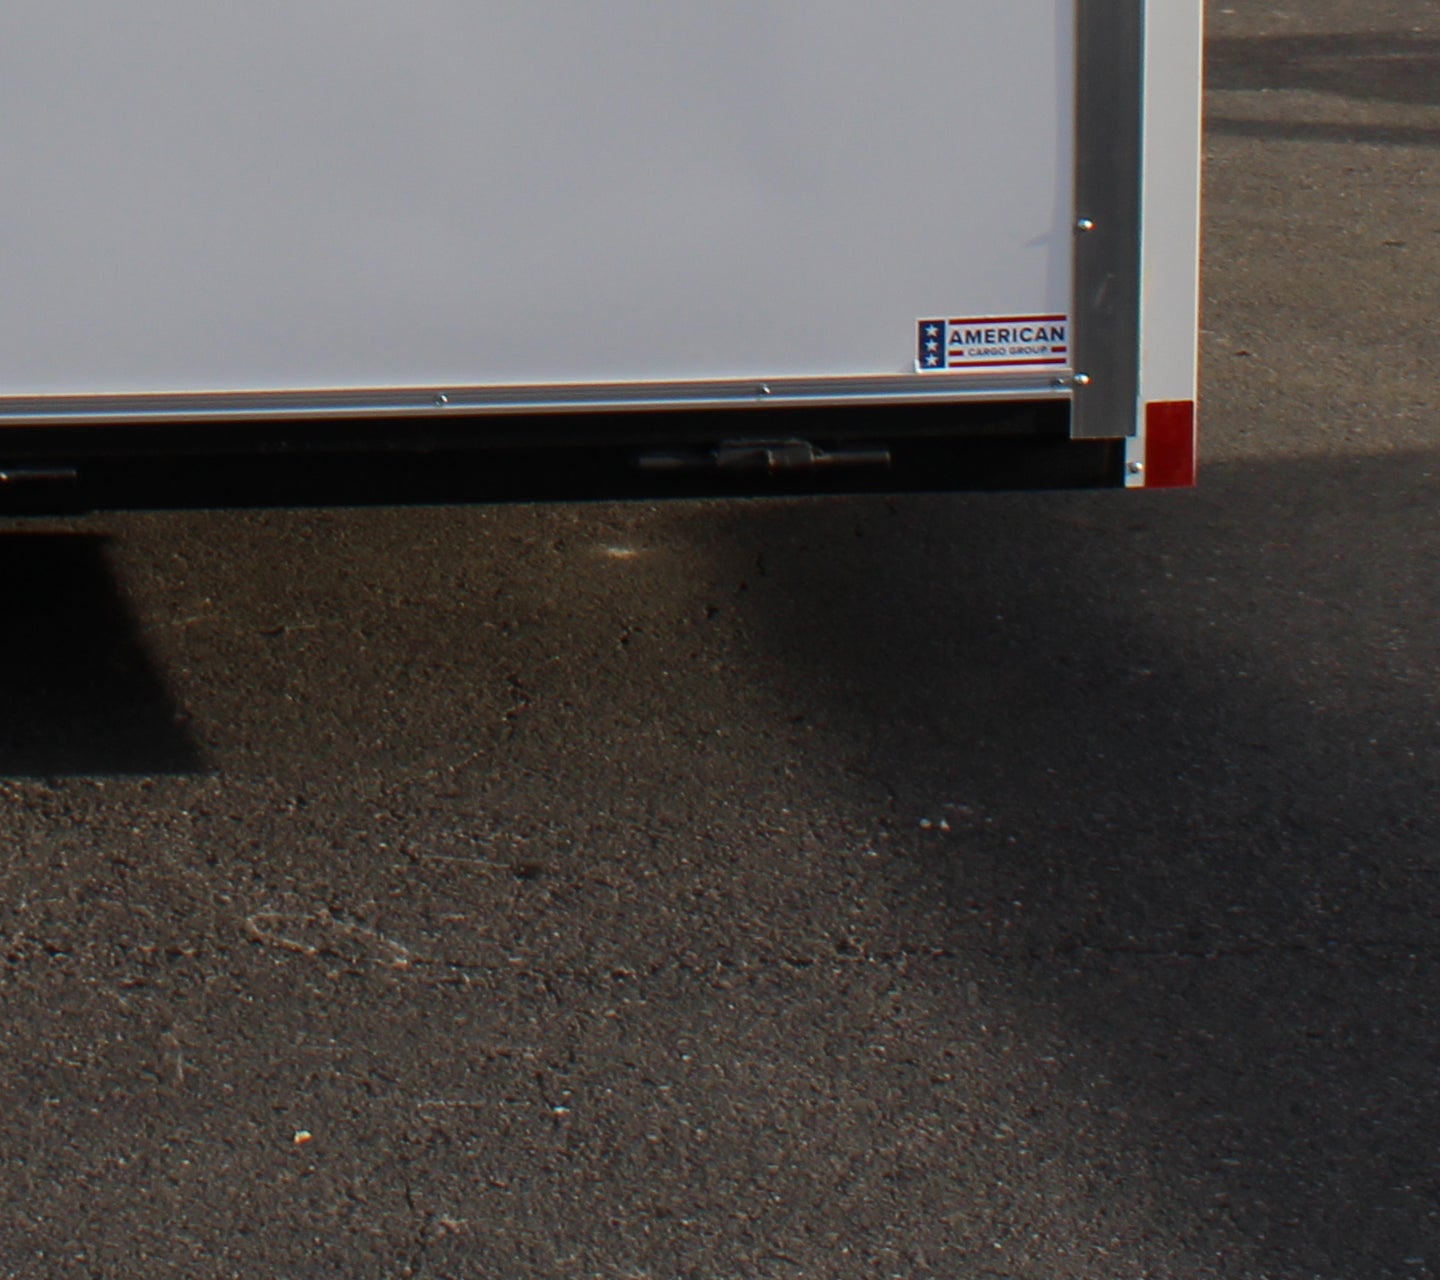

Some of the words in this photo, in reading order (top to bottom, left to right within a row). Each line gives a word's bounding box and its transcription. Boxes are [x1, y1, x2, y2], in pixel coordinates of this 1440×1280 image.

[948, 326, 1066, 345] AMERICAN
[967, 348, 1006, 357] CARGO
[1009, 346, 1049, 355] GROUP
